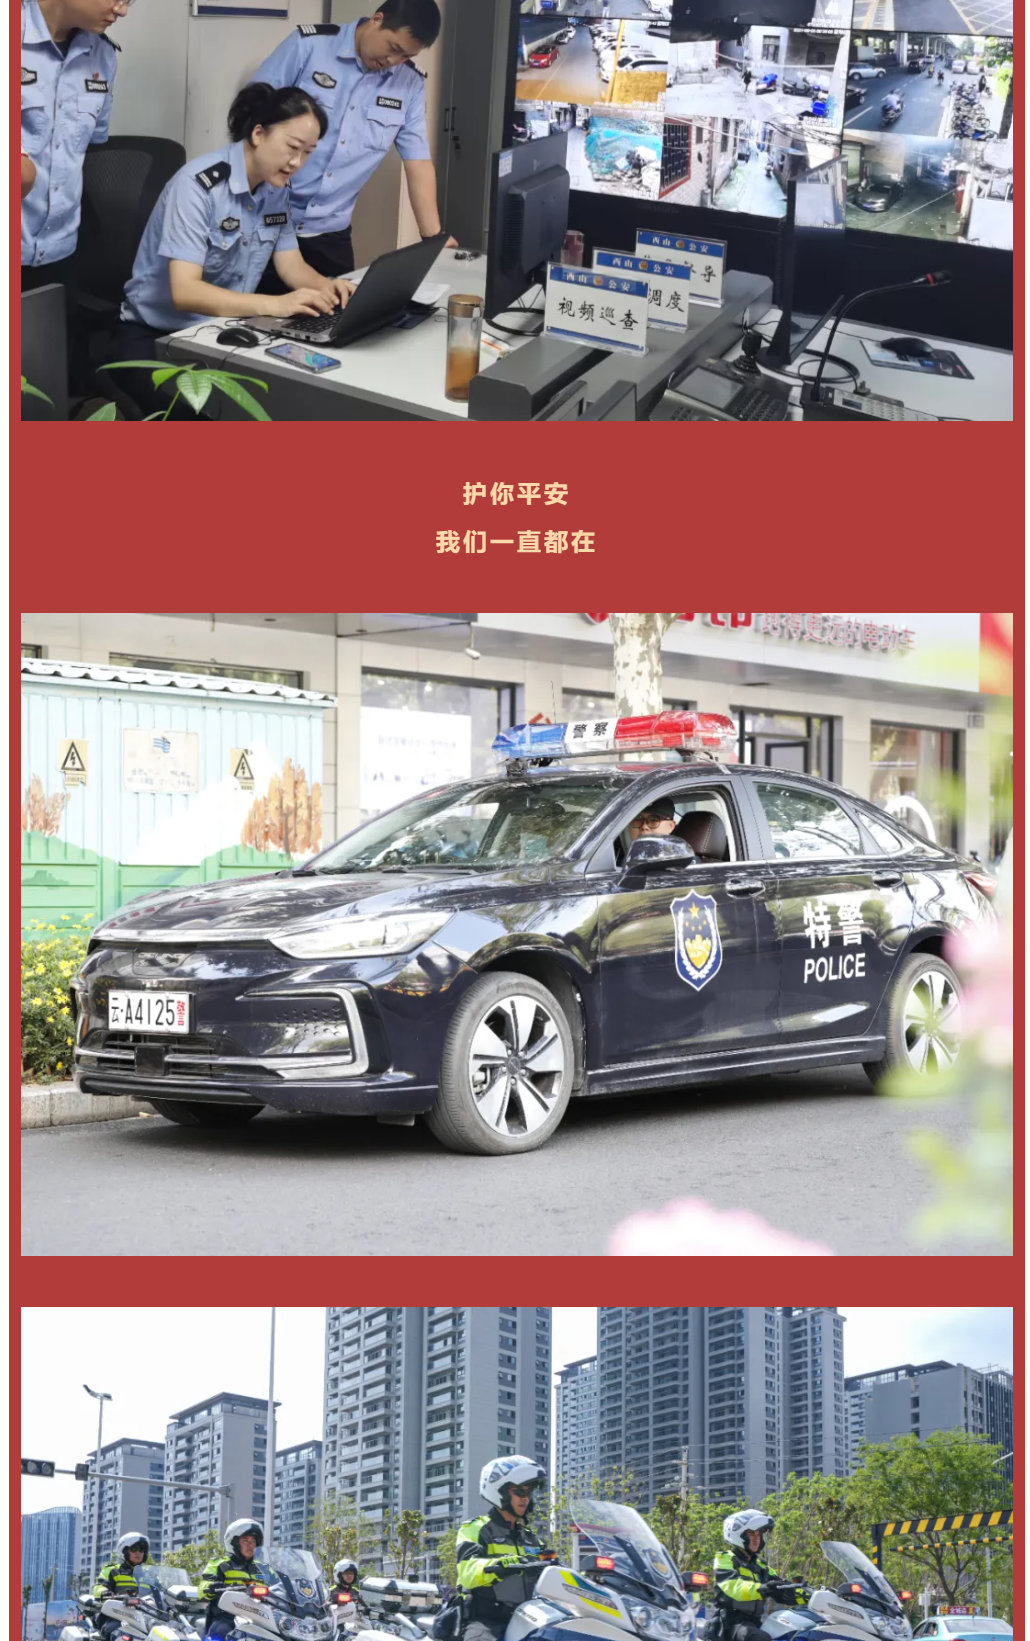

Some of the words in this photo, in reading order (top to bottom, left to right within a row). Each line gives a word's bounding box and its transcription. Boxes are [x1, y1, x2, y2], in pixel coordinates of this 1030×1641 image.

[558, 297, 639, 331] 视频巡查
[572, 720, 609, 739] 警察
[802, 900, 864, 949] 特警
[803, 952, 866, 984] POLICE
